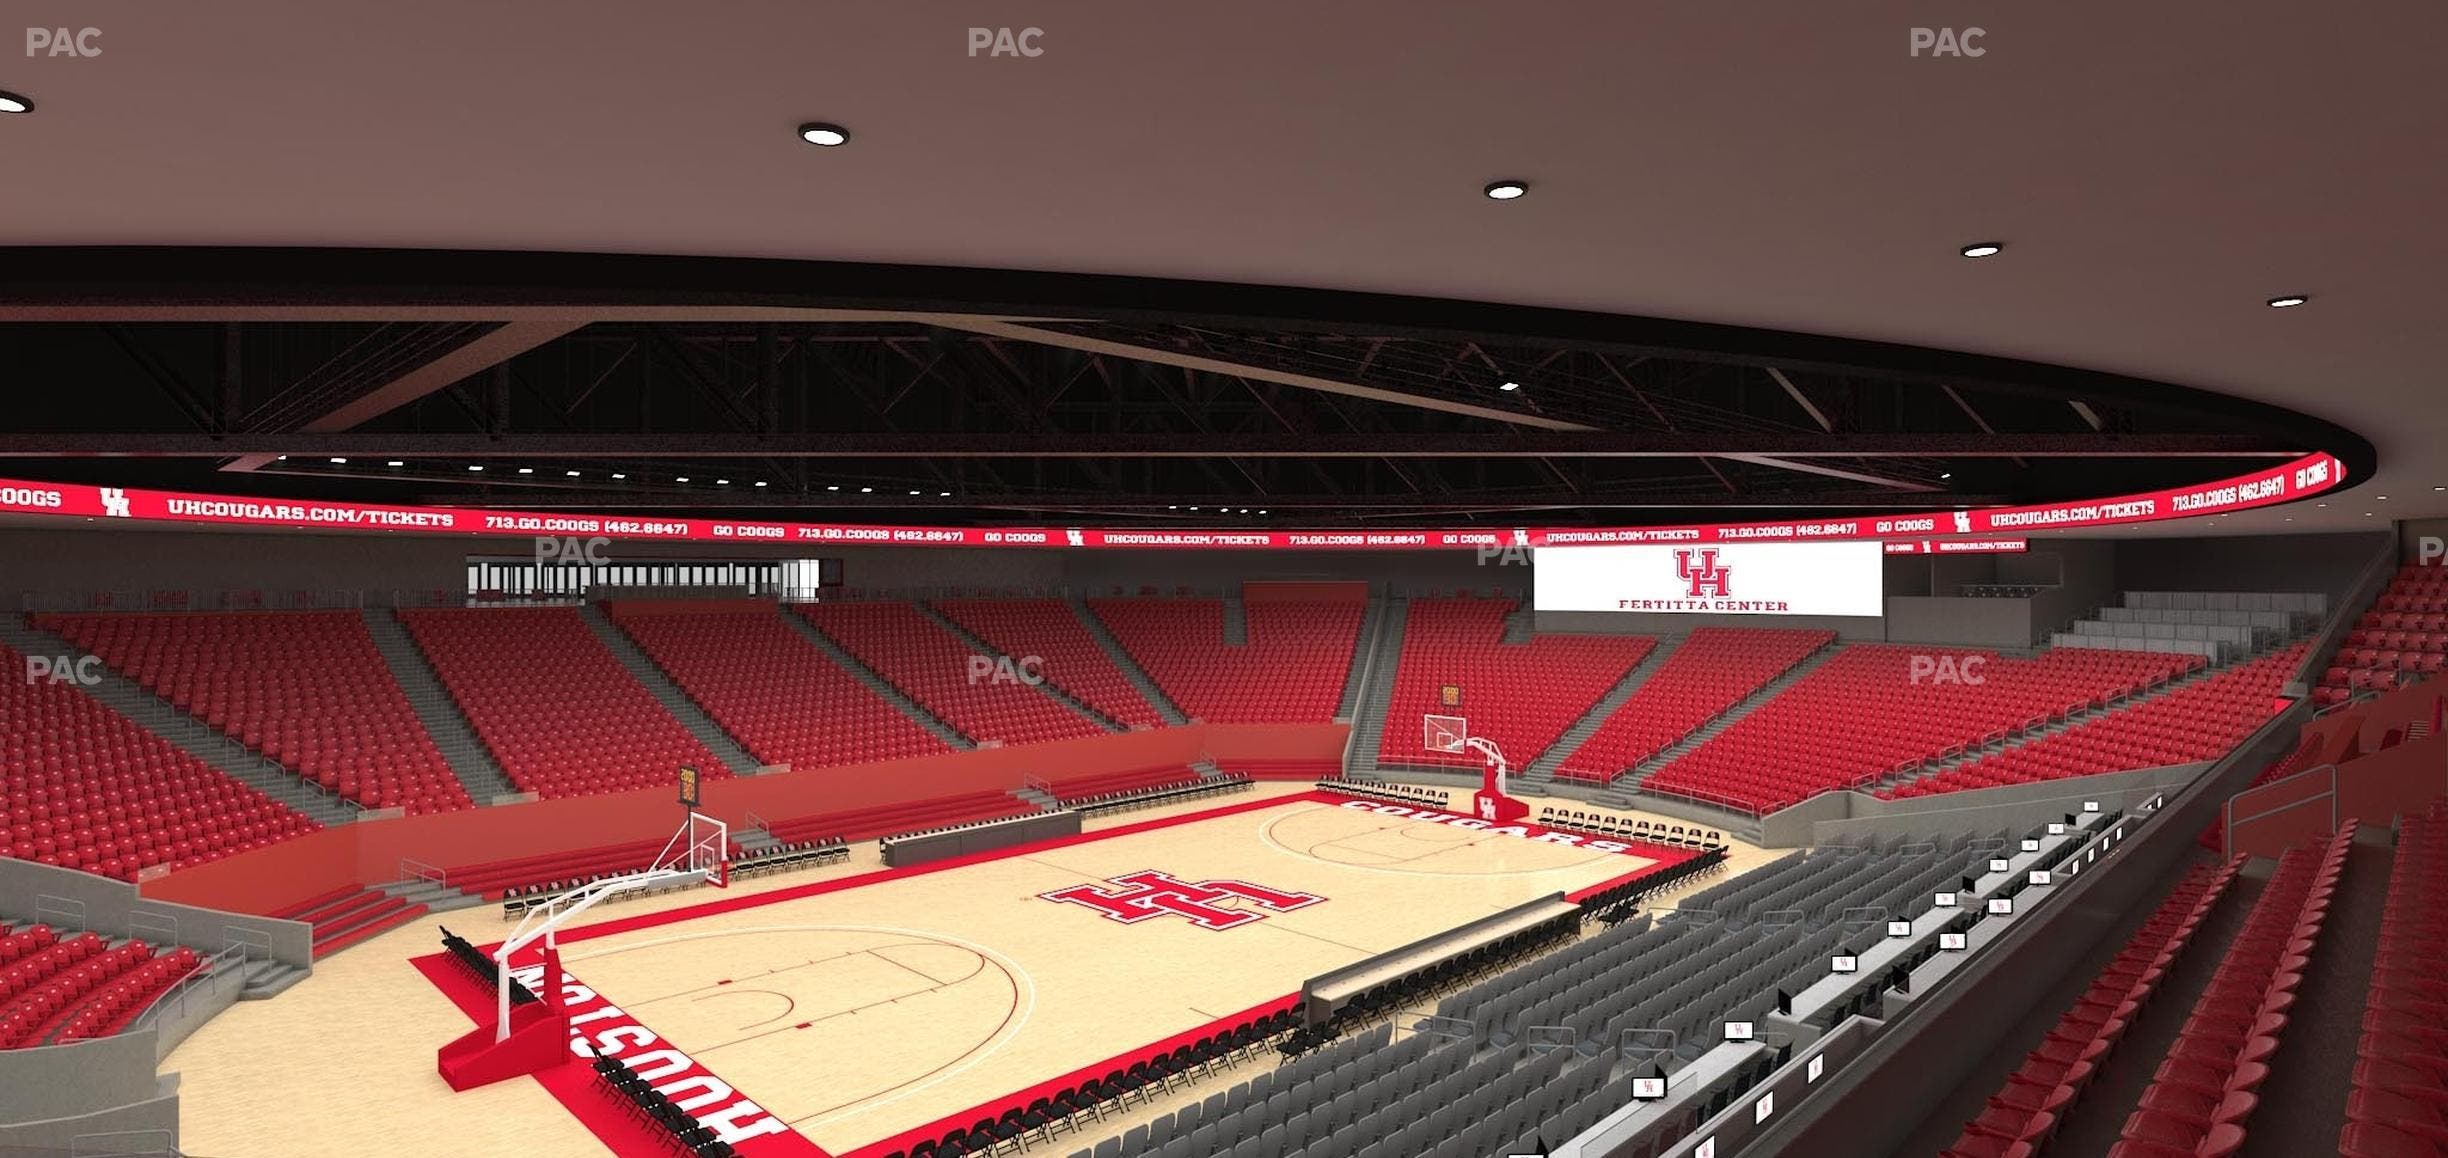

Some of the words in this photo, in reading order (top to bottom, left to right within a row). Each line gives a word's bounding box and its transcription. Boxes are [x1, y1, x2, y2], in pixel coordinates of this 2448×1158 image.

[0, 487, 62, 508] OOGS
[167, 499, 454, 529] UHCOUGARS.COM/TICKETS
[1990, 500, 2155, 528] UHCOUGARS.COM/TICKETS
[485, 517, 600, 532] 713.GO.COOGS
[604, 520, 688, 536] (462.6647)
[713, 525, 733, 536] GO
[737, 526, 785, 538] COOGS
[1876, 521, 1893, 533] GO
[1895, 519, 1935, 532] COOGS
[1618, 599, 1709, 610] FERTITTA
[1715, 600, 1789, 611] CENTER
[1340, 800, 1633, 852] COUGARS
